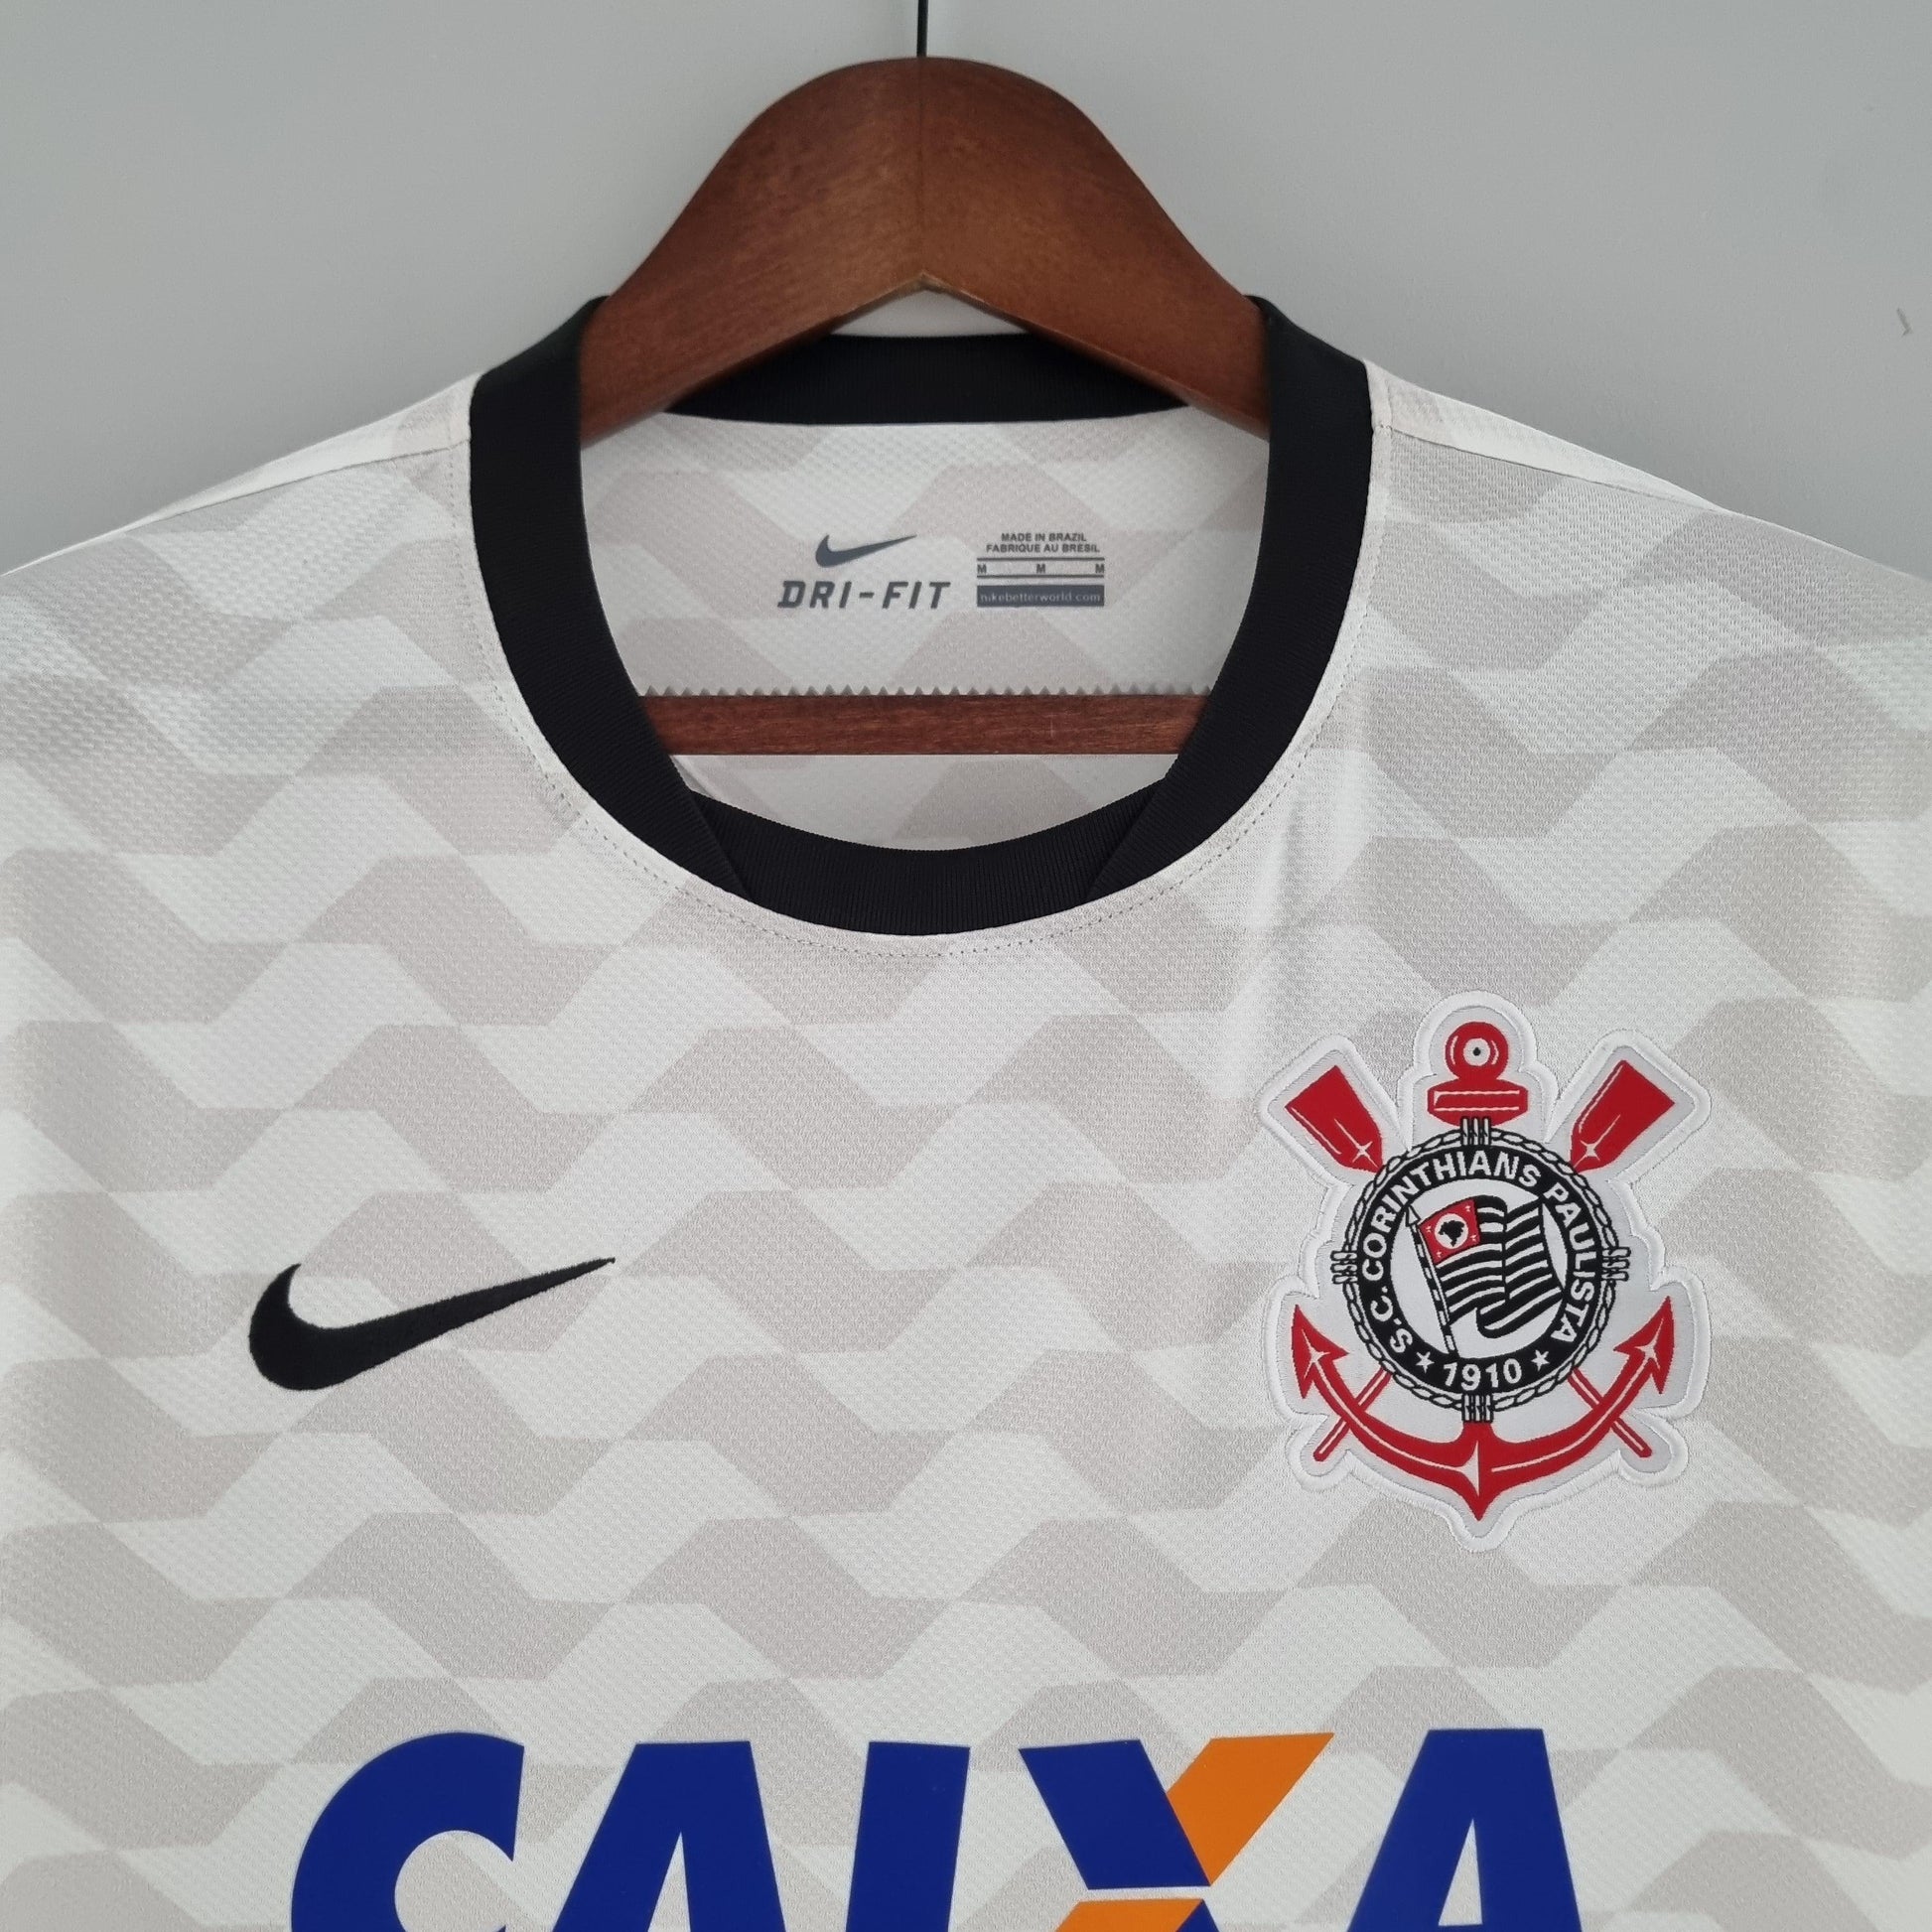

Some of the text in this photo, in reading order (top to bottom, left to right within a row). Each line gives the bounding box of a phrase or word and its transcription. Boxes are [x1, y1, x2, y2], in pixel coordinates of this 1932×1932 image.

[1001, 532, 1087, 542] MADE IN BRAZIL
[986, 543, 1041, 553] FABRIQUE
[1043, 543, 1059, 553] AU
[977, 563, 1105, 574] M M M
[777, 580, 951, 609] DRI-FIT
[980, 591, 1102, 603] nikebetterworld.com
[1361, 1150, 1542, 1282] CORINTHIANS
[1543, 1184, 1598, 1343] PAULISTA
[1443, 1357, 1524, 1392] 1910
[290, 1727, 1585, 1932] CAIXA
